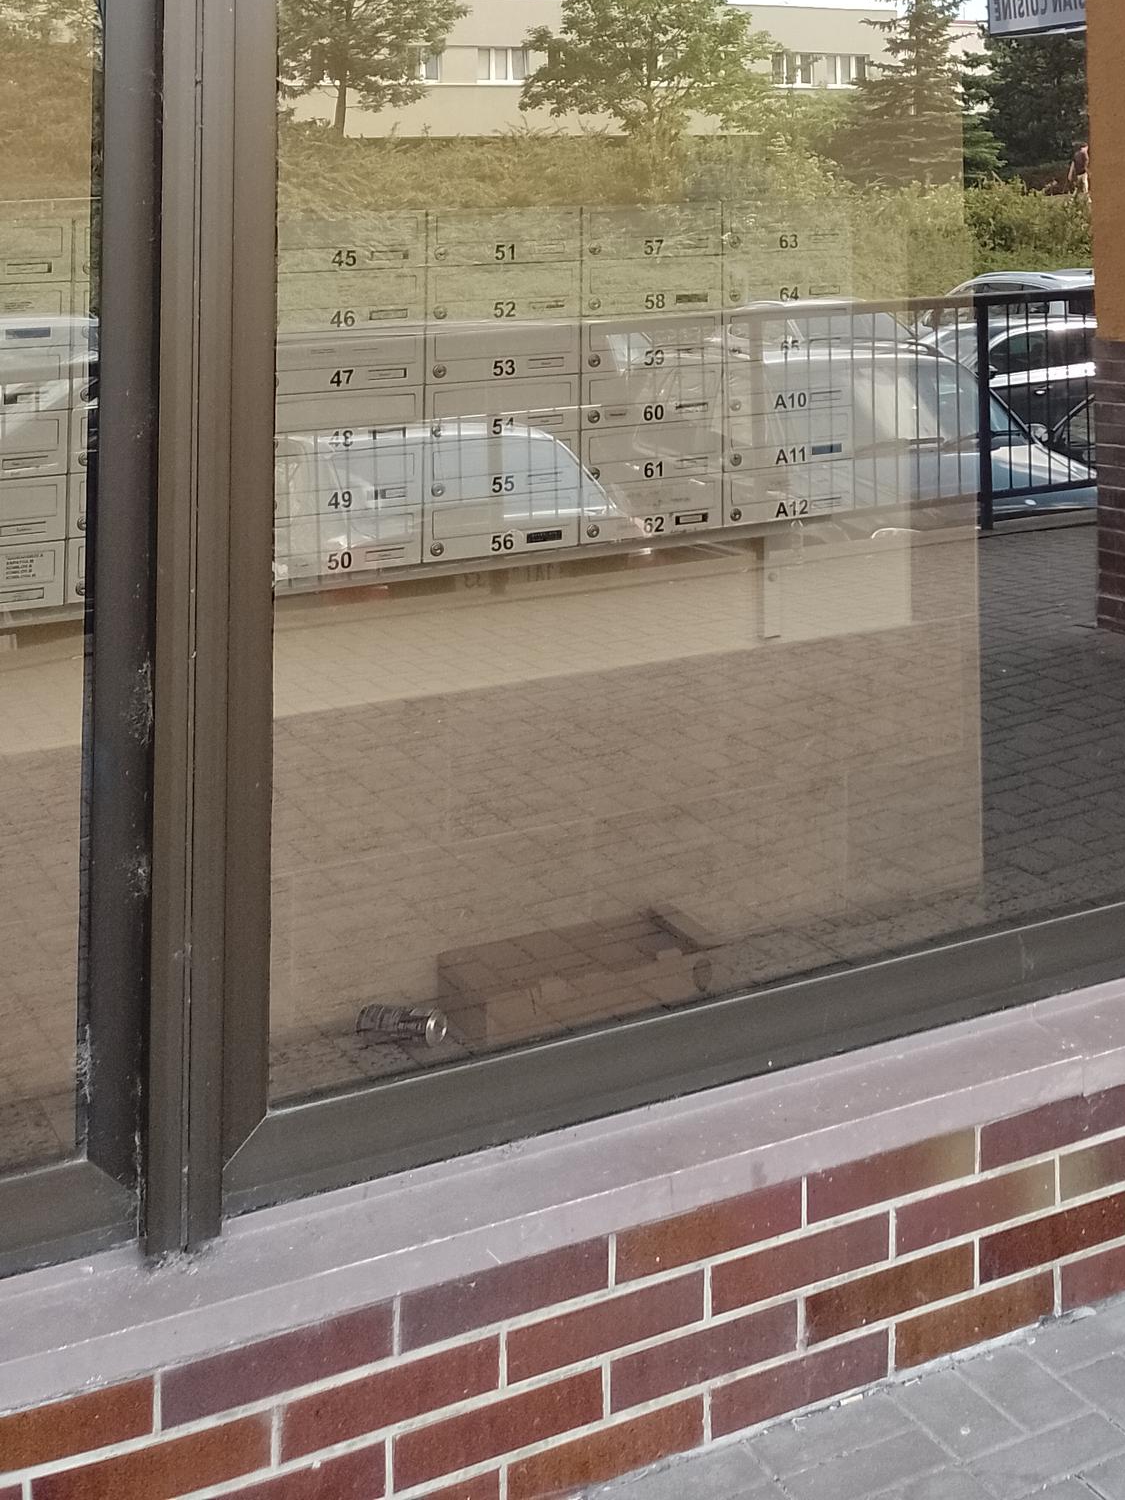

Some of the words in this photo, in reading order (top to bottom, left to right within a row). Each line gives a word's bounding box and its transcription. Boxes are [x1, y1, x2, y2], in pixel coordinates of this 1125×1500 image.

[644, 239, 665, 256] 57
[779, 233, 799, 250] 63
[332, 250, 357, 268] 45
[494, 243, 517, 262] 51
[644, 293, 666, 311] 58
[779, 287, 800, 302] 64
[493, 301, 516, 319] 52
[330, 310, 356, 329] 46
[644, 350, 665, 367] 59
[492, 359, 516, 377] 53
[329, 369, 355, 388] 47
[774, 392, 807, 410] A10
[643, 404, 665, 422] 60
[492, 417, 515, 435] 54
[775, 447, 807, 465] A11
[644, 461, 665, 479] 61
[491, 475, 515, 493] 55
[327, 490, 353, 510] 49
[775, 499, 809, 518] A12
[644, 516, 665, 534] 62
[491, 533, 515, 552] 56
[326, 551, 352, 571] 50
